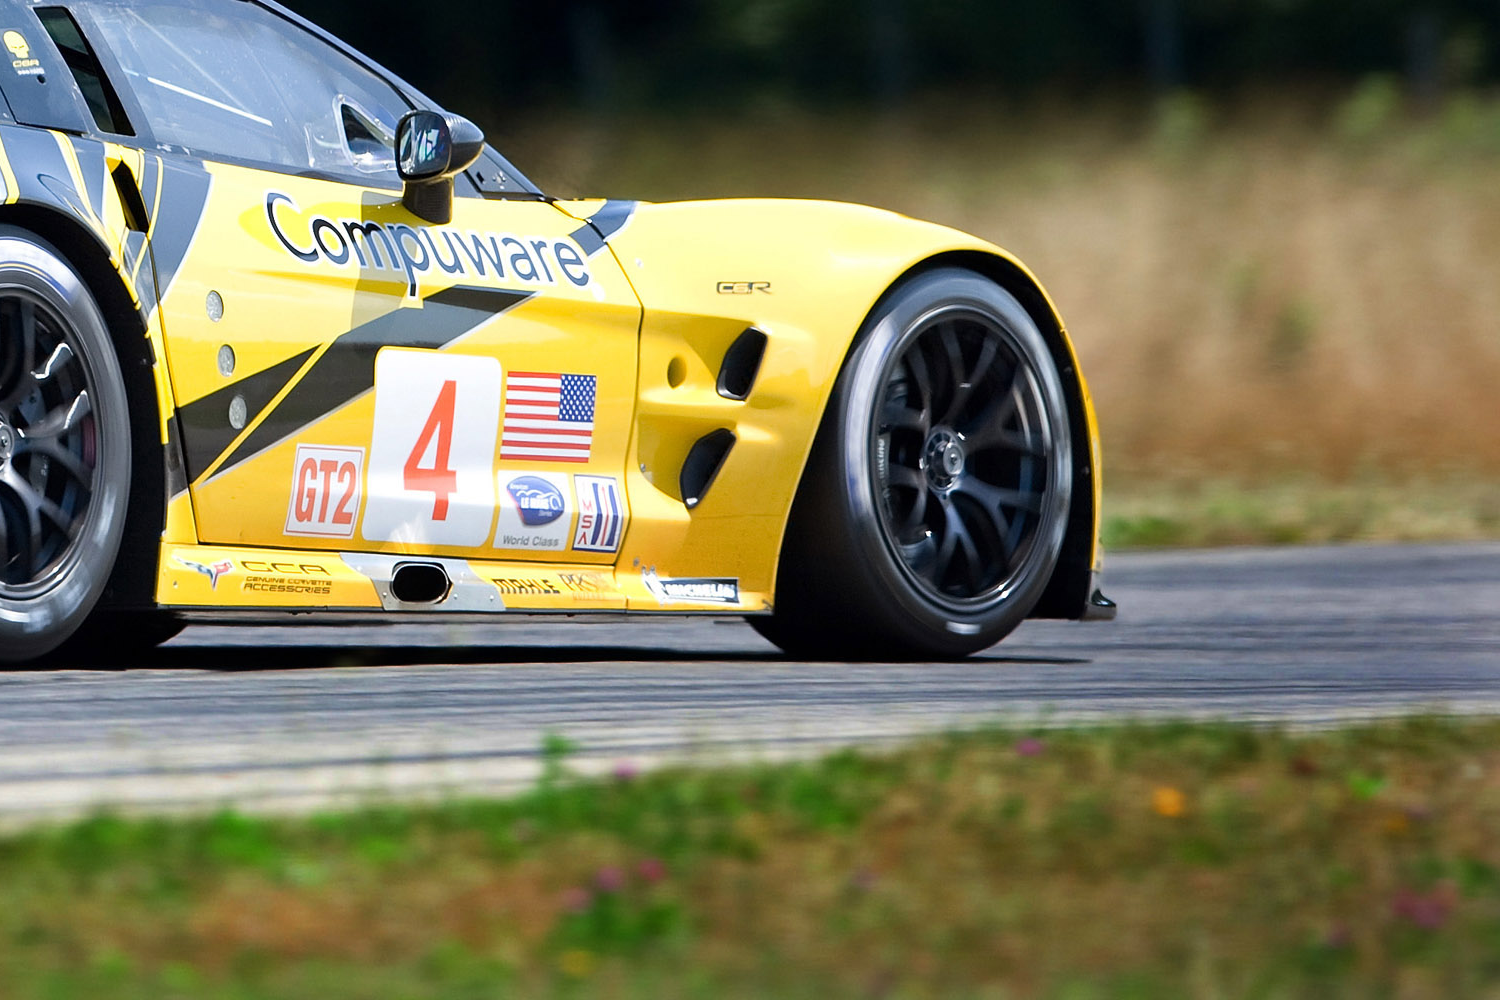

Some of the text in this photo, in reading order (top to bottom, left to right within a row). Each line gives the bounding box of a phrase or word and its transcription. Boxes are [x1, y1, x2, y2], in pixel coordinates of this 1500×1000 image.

[266, 191, 590, 297] Compuware
[403, 379, 458, 521] 4
[294, 457, 357, 525] GT2
[503, 535, 559, 547] World Class
[243, 583, 331, 594] ACCESSORIES
[245, 576, 332, 586] GENUINE CORVETTE
[491, 577, 561, 595] MAHLE
